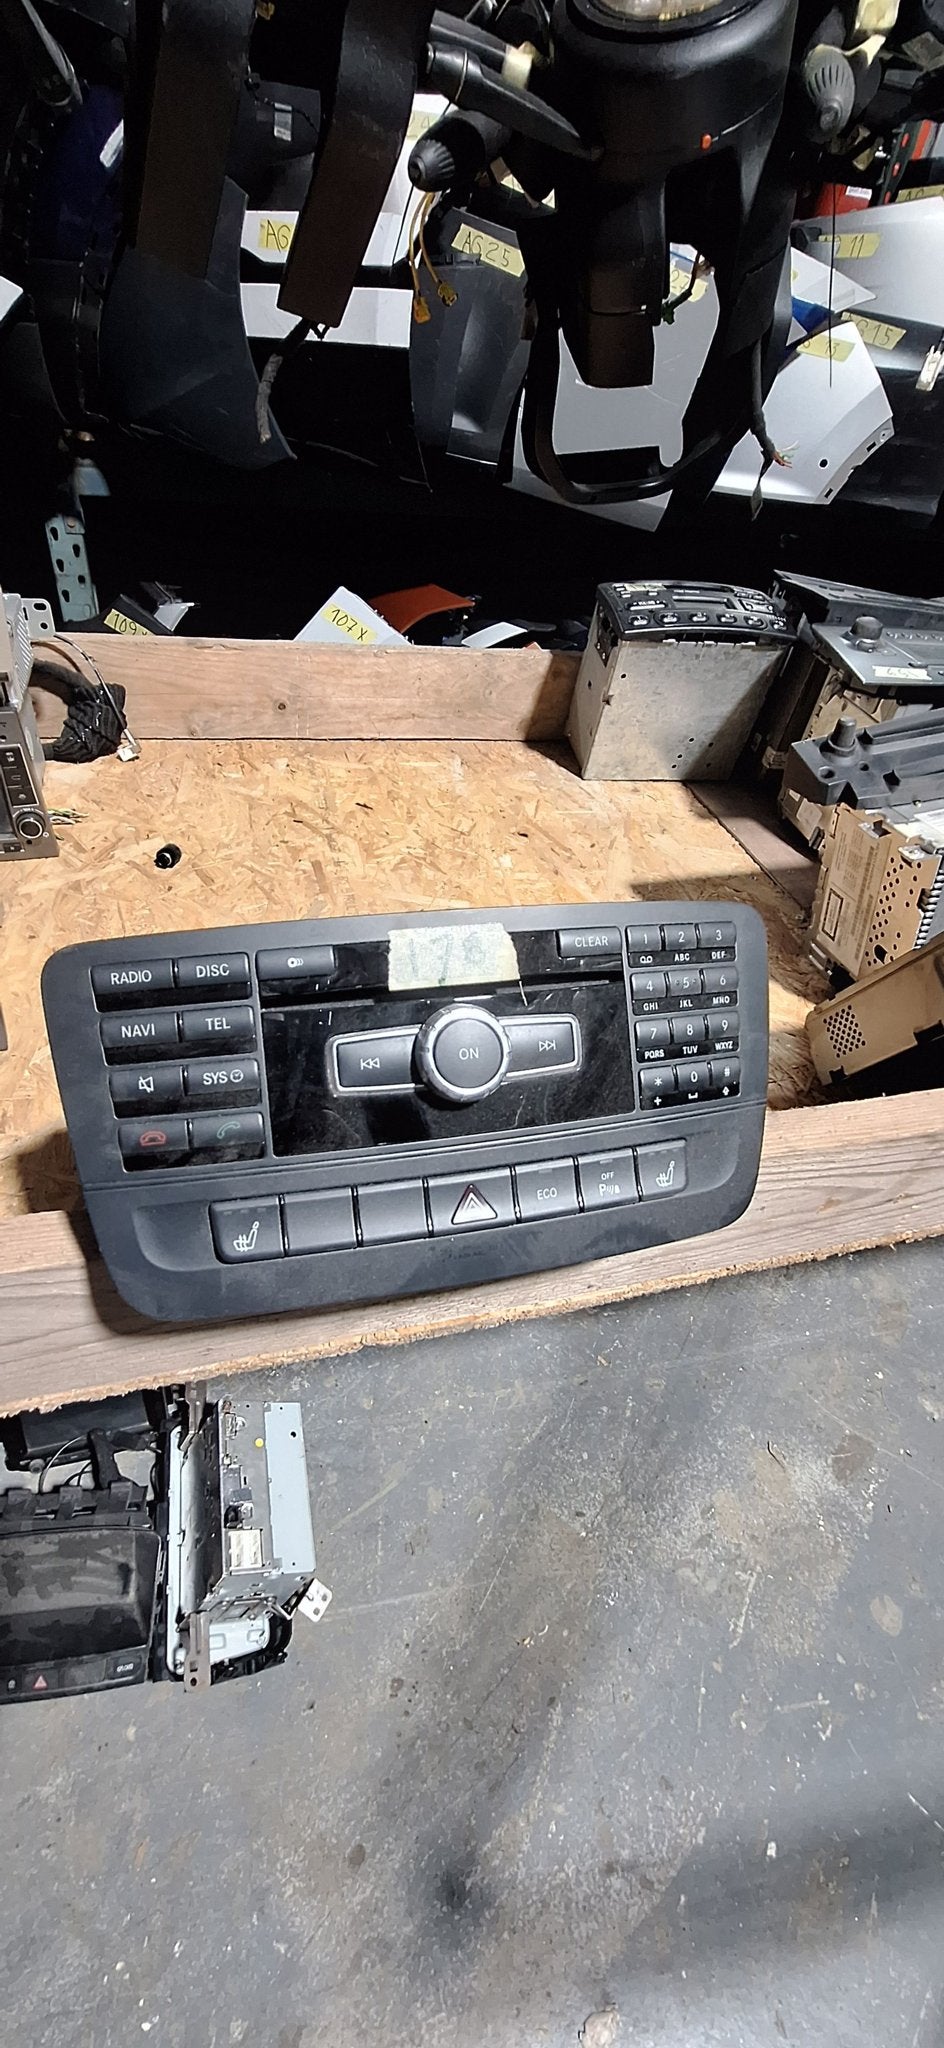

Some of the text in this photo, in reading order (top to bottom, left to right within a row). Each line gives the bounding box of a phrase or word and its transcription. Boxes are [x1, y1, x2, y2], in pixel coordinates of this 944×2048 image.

[643, 933, 648, 945] 1
[678, 931, 686, 943] 2
[715, 929, 722, 941] 3
[574, 936, 609, 948] CLEAR
[674, 953, 690, 962] ABC
[711, 950, 727, 960] DEF
[195, 963, 230, 979] DISC
[110, 969, 152, 986] RADIO
[683, 977, 690, 989] 5
[720, 975, 727, 986] 6
[646, 980, 654, 992] 4
[679, 1000, 693, 1008] JKL
[712, 996, 730, 1004] MNO
[643, 1002, 659, 1011] GHI
[205, 1016, 231, 1031] TEL
[721, 1019, 729, 1031] 9
[121, 1023, 156, 1039] NAVI
[650, 1028, 657, 1040] 7
[686, 1024, 694, 1036] 8
[682, 1045, 699, 1055] TUV
[714, 1040, 734, 1051] WXYZ
[459, 1047, 479, 1060] ON
[644, 1049, 665, 1059] PQRS
[203, 1071, 228, 1085] SYS
[690, 1070, 698, 1083] 0
[601, 1171, 614, 1180] OFF
[537, 1187, 558, 1199] ECO
